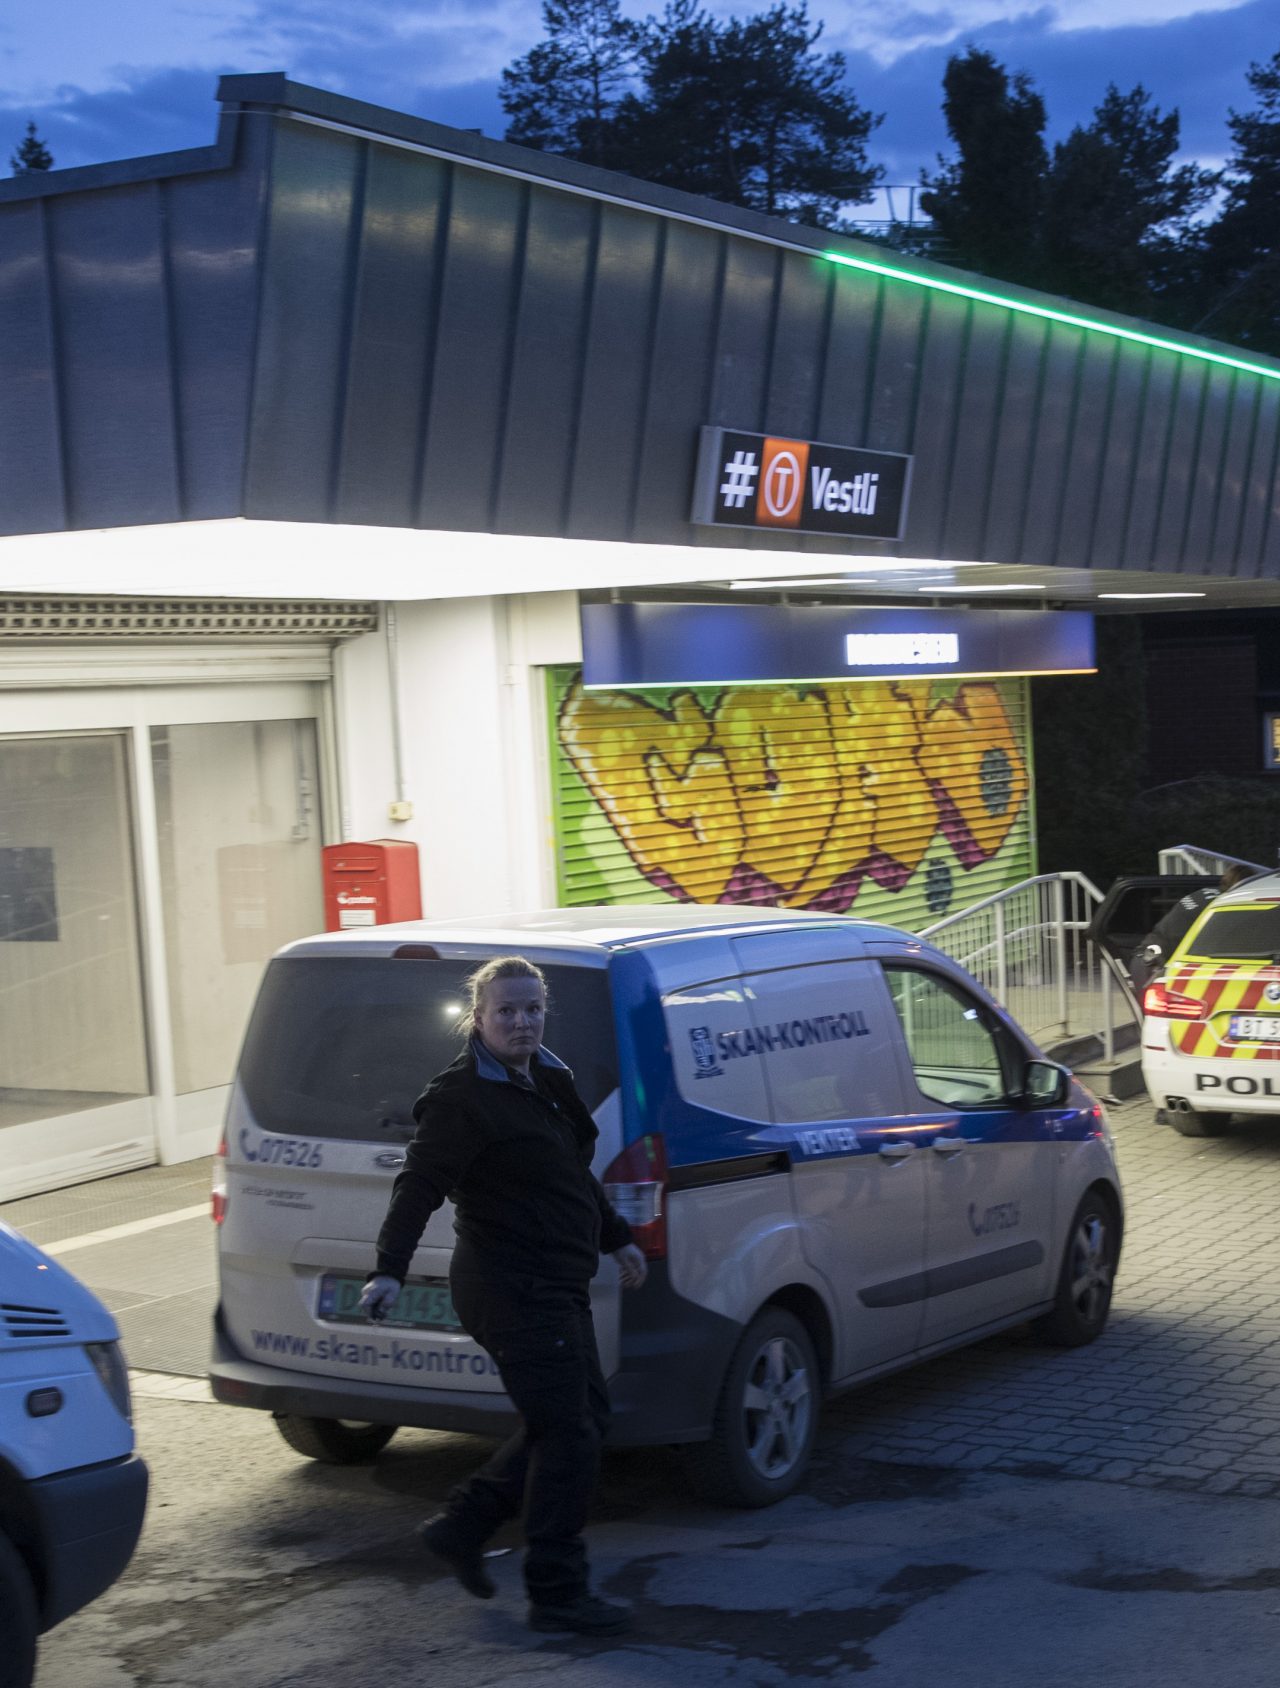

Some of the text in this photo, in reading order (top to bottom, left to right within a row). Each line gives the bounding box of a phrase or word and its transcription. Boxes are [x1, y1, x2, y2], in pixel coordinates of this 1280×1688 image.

[811, 465, 879, 515] Vestli
[717, 1010, 871, 1061] SKAN-KONTROLL
[1243, 1019, 1264, 1035] BT
[258, 1138, 324, 1168] 07526
